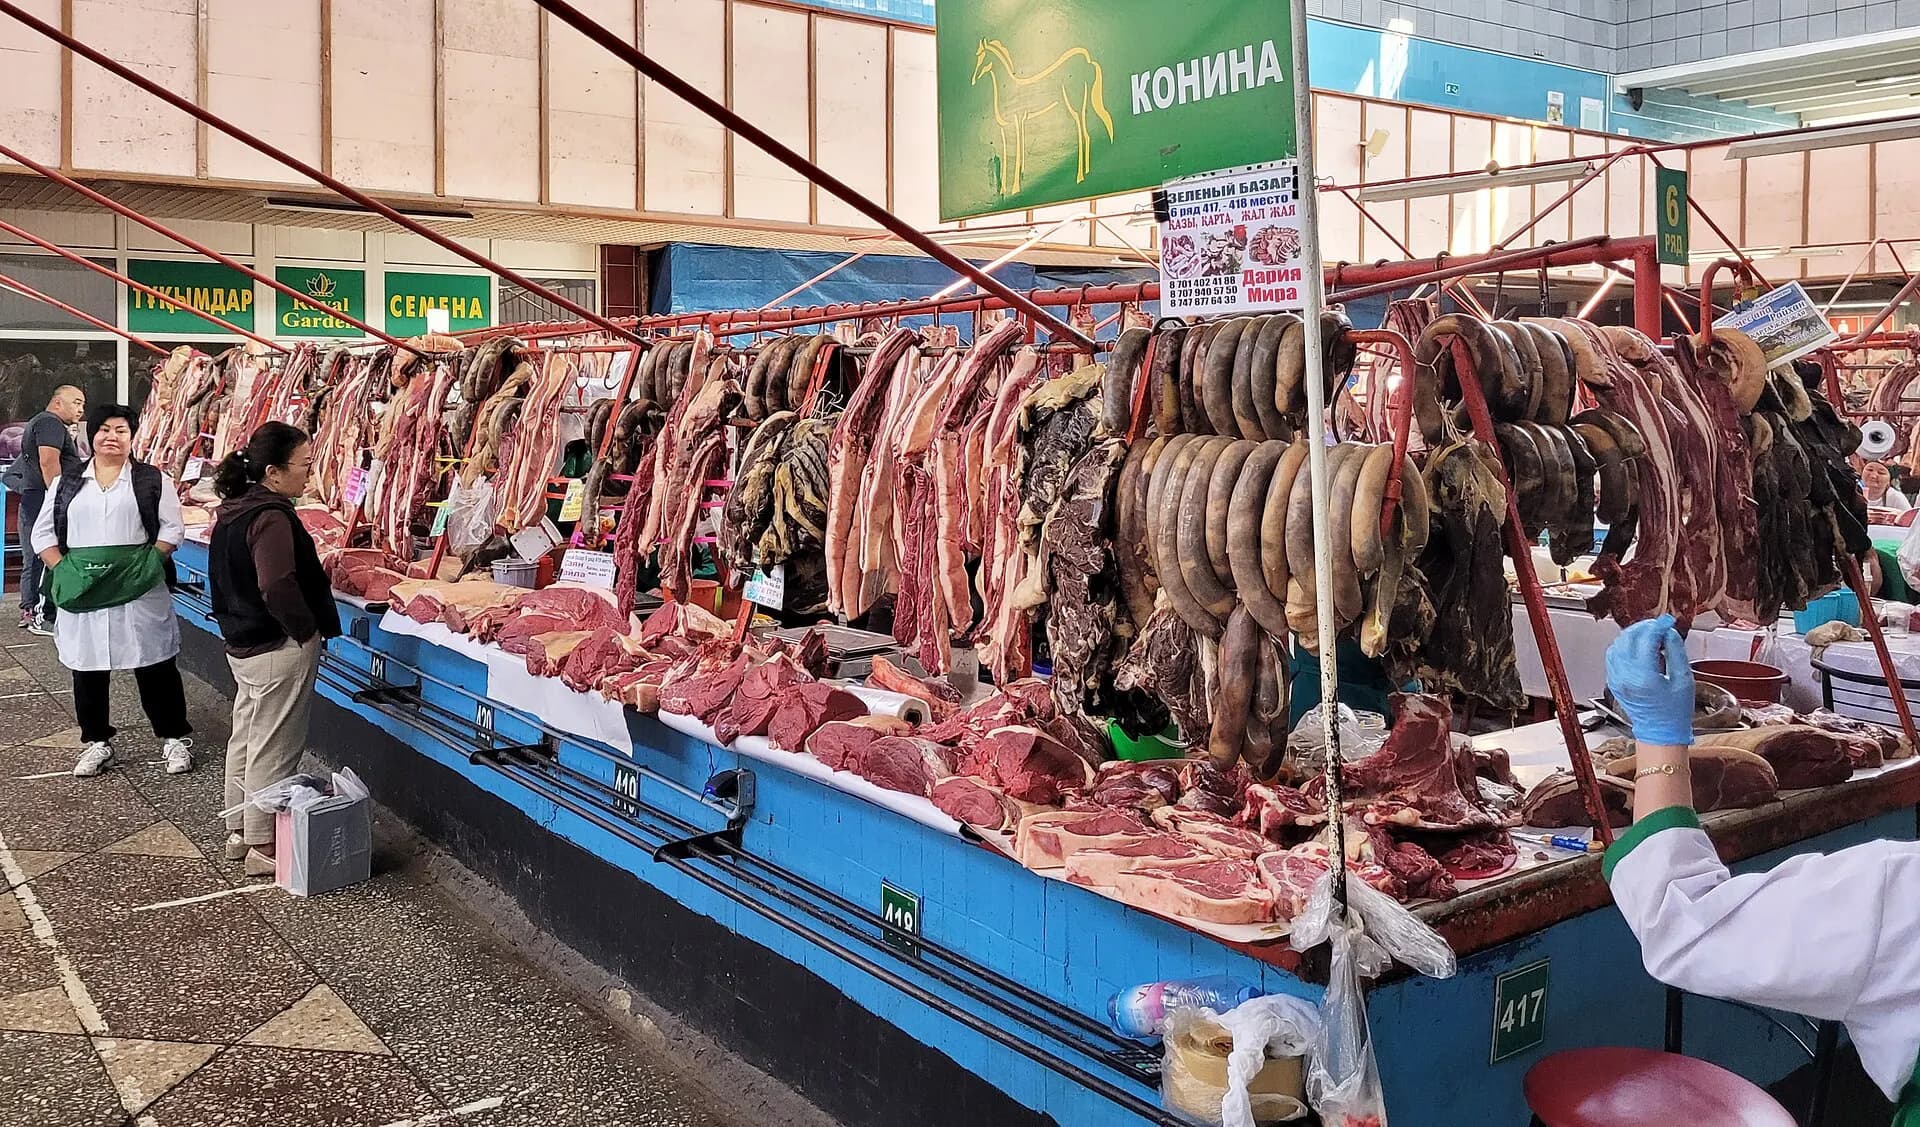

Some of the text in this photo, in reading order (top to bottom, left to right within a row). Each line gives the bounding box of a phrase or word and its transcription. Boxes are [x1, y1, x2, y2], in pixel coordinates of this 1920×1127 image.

[1131, 39, 1284, 115] КОНИНА
[1168, 176, 1291, 204] ЗЕЛЕНЫЙ БАЗАР
[1170, 207, 1177, 218] 6
[1180, 206, 1201, 219] ряд
[1228, 199, 1247, 211] 418
[1250, 194, 1289, 206] место
[1241, 207, 1265, 221] ЖАЛ
[1270, 204, 1296, 218] ЖАЯ
[1666, 184, 1680, 227] 6
[1664, 233, 1683, 257] РЯД
[1170, 276, 1236, 289] 8 701 402 41 88
[1242, 268, 1302, 287] Дария
[1170, 285, 1238, 298] 8 707 940 57 50
[1170, 295, 1236, 307] 8 747 877 64 39
[1248, 287, 1297, 303] Мира
[292, 297, 349, 315] Ryal
[390, 294, 483, 319] СЕМЕНА
[1769, 300, 1806, 321] Райхан
[282, 312, 357, 329] Garde
[476, 704, 492, 741] 420
[1500, 987, 1545, 1033] 417
